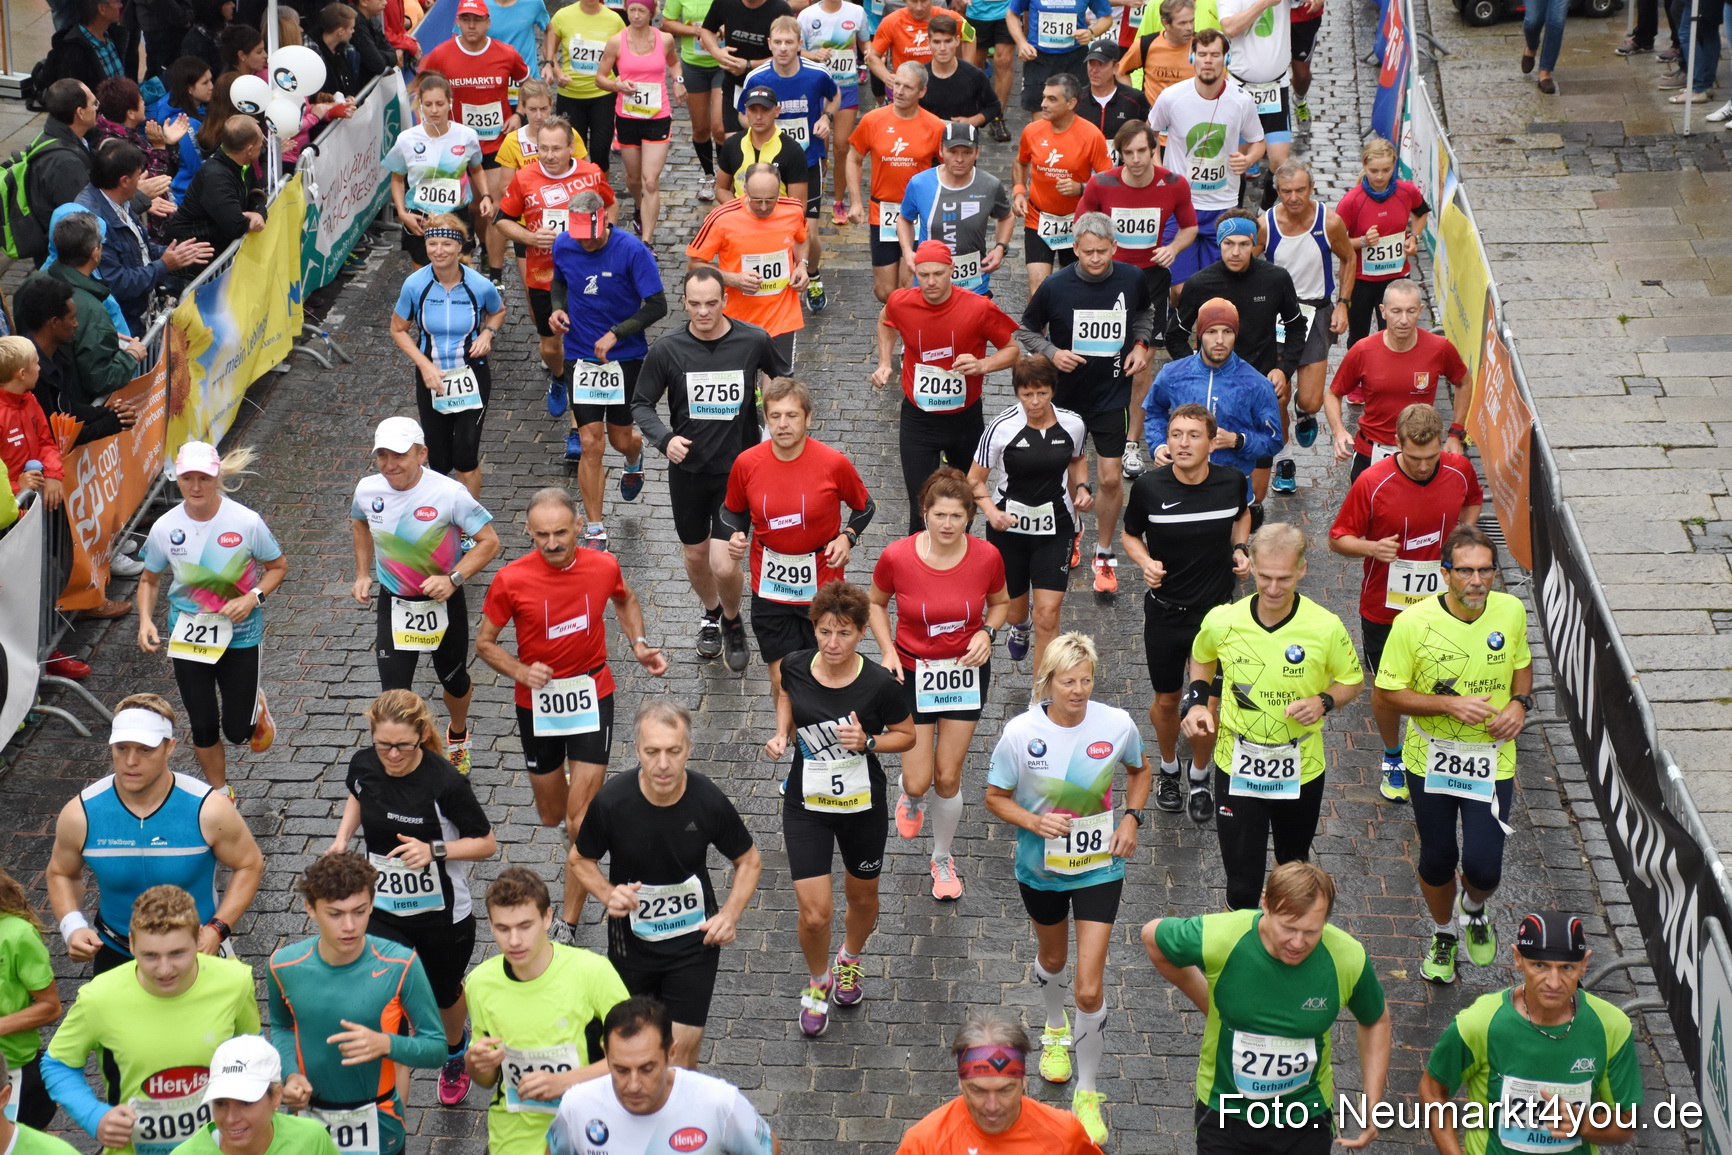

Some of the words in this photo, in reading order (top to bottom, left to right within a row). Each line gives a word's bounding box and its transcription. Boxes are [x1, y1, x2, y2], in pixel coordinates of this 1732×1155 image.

[1042, 21, 1073, 36] 2518
[573, 47, 604, 62] 2217
[450, 76, 494, 88] NEUMARKT
[634, 91, 649, 106] 51
[467, 112, 499, 128] 2352
[1191, 167, 1225, 182] 2450
[419, 187, 457, 204] 3064
[1116, 219, 1156, 234] 3046
[1366, 242, 1403, 262] 2519
[1374, 262, 1396, 271] Marina
[1078, 322, 1122, 339] 3009
[579, 371, 620, 388] 2786
[919, 376, 963, 395] 2043
[693, 383, 740, 402] 2756
[928, 398, 952, 407] Robert
[696, 405, 739, 416] Christopher
[766, 561, 812, 584] 2299
[773, 584, 803, 596] Manfred
[1402, 573, 1438, 592] 170
[405, 610, 438, 632] 220
[183, 622, 219, 644] 221
[404, 634, 440, 646] Christoph
[193, 645, 208, 656] Eva
[1486, 653, 1506, 662] Partl
[1282, 666, 1305, 675] Partl
[922, 668, 974, 691] 2060
[1480, 678, 1497, 687] NEXT
[1484, 684, 1506, 693] YEARS
[539, 689, 592, 714] 3005
[934, 694, 963, 704] Andrea
[1267, 699, 1281, 707] 100
[1089, 745, 1111, 755] Hervis
[1239, 754, 1296, 778] 2828
[1433, 752, 1490, 778] 2843
[831, 774, 845, 796] 5
[1246, 781, 1284, 792] Helmuth
[1447, 779, 1473, 791] Claus
[818, 797, 859, 807] Marianne
[392, 814, 424, 825] PFLEIDERER
[1061, 829, 1102, 854] 198
[1068, 856, 1092, 868] Heidi
[376, 870, 435, 894] 2806
[393, 899, 418, 909] Irene
[638, 893, 698, 919] 2236
[651, 918, 686, 933] Johann
[1301, 997, 1328, 1009] AOK
[222, 1066, 244, 1074] PUMA
[1241, 1050, 1309, 1077] 2753
[1570, 1057, 1597, 1070] AOK
[148, 1071, 209, 1097] Hervis
[1251, 1080, 1294, 1092] Gerhard
[139, 1101, 213, 1140] 3099
[675, 1133, 703, 1146] Hervis
